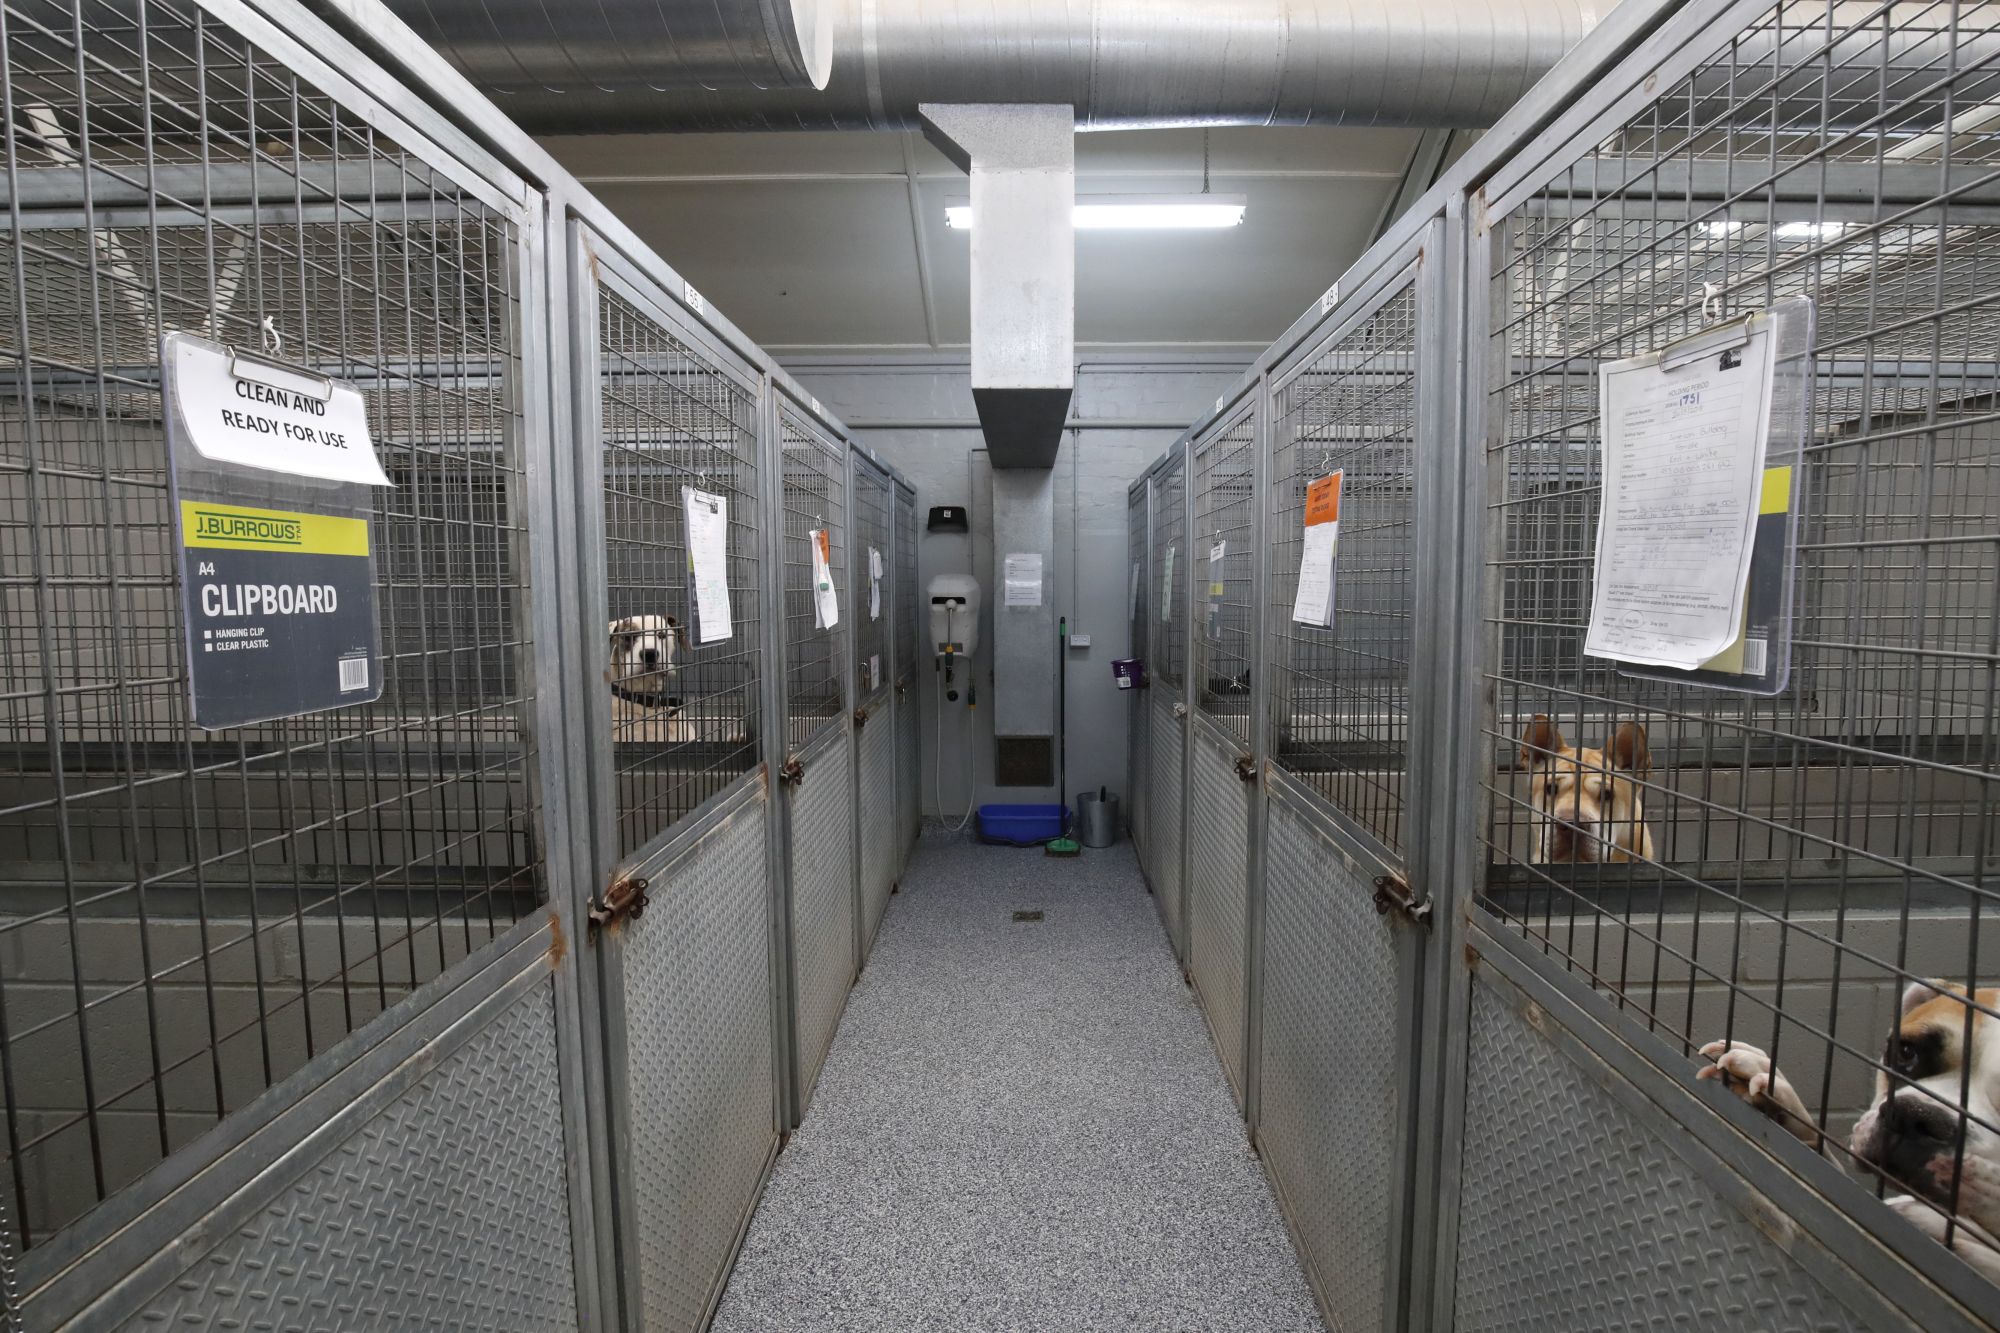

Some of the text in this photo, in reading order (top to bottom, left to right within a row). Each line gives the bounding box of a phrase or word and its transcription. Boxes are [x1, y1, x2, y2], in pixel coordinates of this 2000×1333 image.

[1326, 289, 1333, 306] 48
[235, 380, 325, 416] CLEAN AND
[221, 409, 348, 449] READY FOR USE
[196, 516, 296, 540] J.BURROWS
[198, 562, 215, 576] A4
[201, 583, 338, 617] CLIPBOARD
[215, 627, 265, 638] HANGING CLIP
[216, 639, 269, 651] CLEAR PLASTIC
